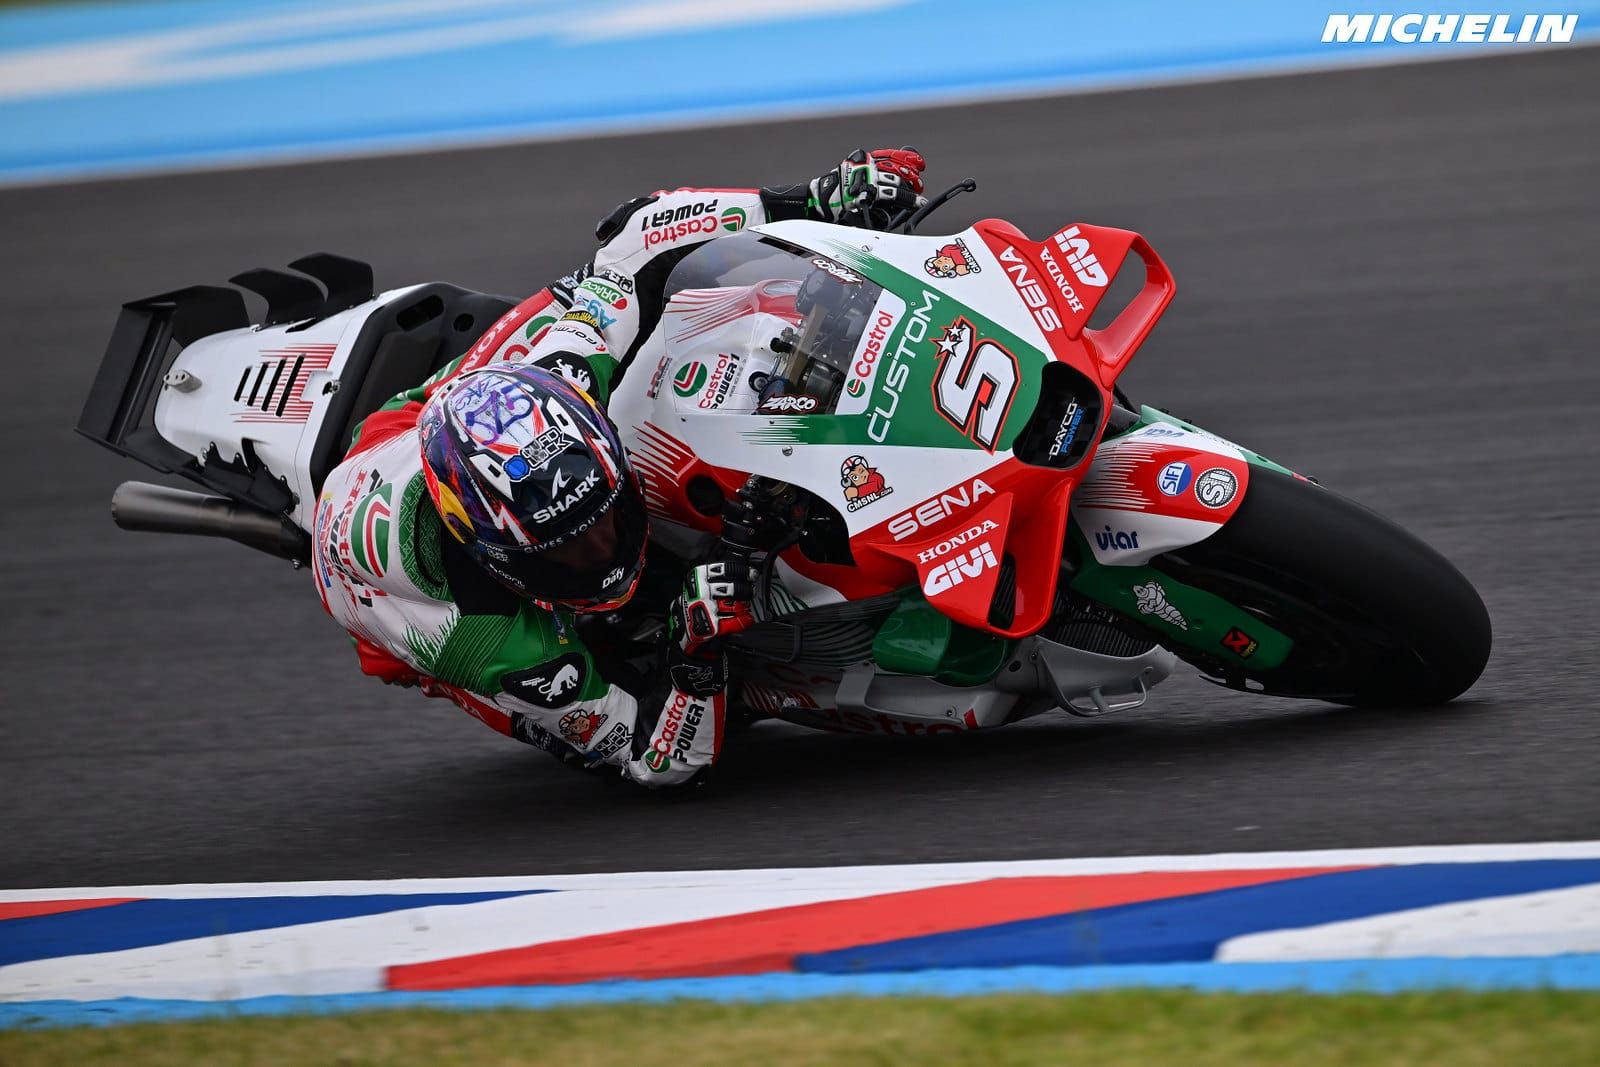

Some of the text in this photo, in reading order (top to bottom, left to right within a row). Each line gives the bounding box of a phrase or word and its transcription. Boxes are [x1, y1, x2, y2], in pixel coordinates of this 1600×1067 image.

[644, 215, 718, 250] Castrol
[1054, 225, 1108, 287] GIVI
[1000, 245, 1062, 332] SENA
[1039, 245, 1084, 313] HONDA
[855, 310, 894, 378] Castrol
[867, 289, 941, 443] CUSTOM
[698, 353, 729, 409] Castrol
[930, 315, 1021, 456] 5
[1048, 402, 1078, 457] DAYCO
[1060, 408, 1086, 454] POWER
[532, 468, 600, 523] SHARK
[1161, 464, 1183, 496] SIFI
[524, 537, 563, 553] GIVES
[569, 516, 596, 536] YOU
[887, 478, 996, 542] SENA
[1095, 525, 1139, 550] viar
[917, 519, 999, 564] HONDA
[923, 541, 998, 597] GIVI
[602, 567, 625, 589] Dafy
[653, 691, 689, 757] Castro
